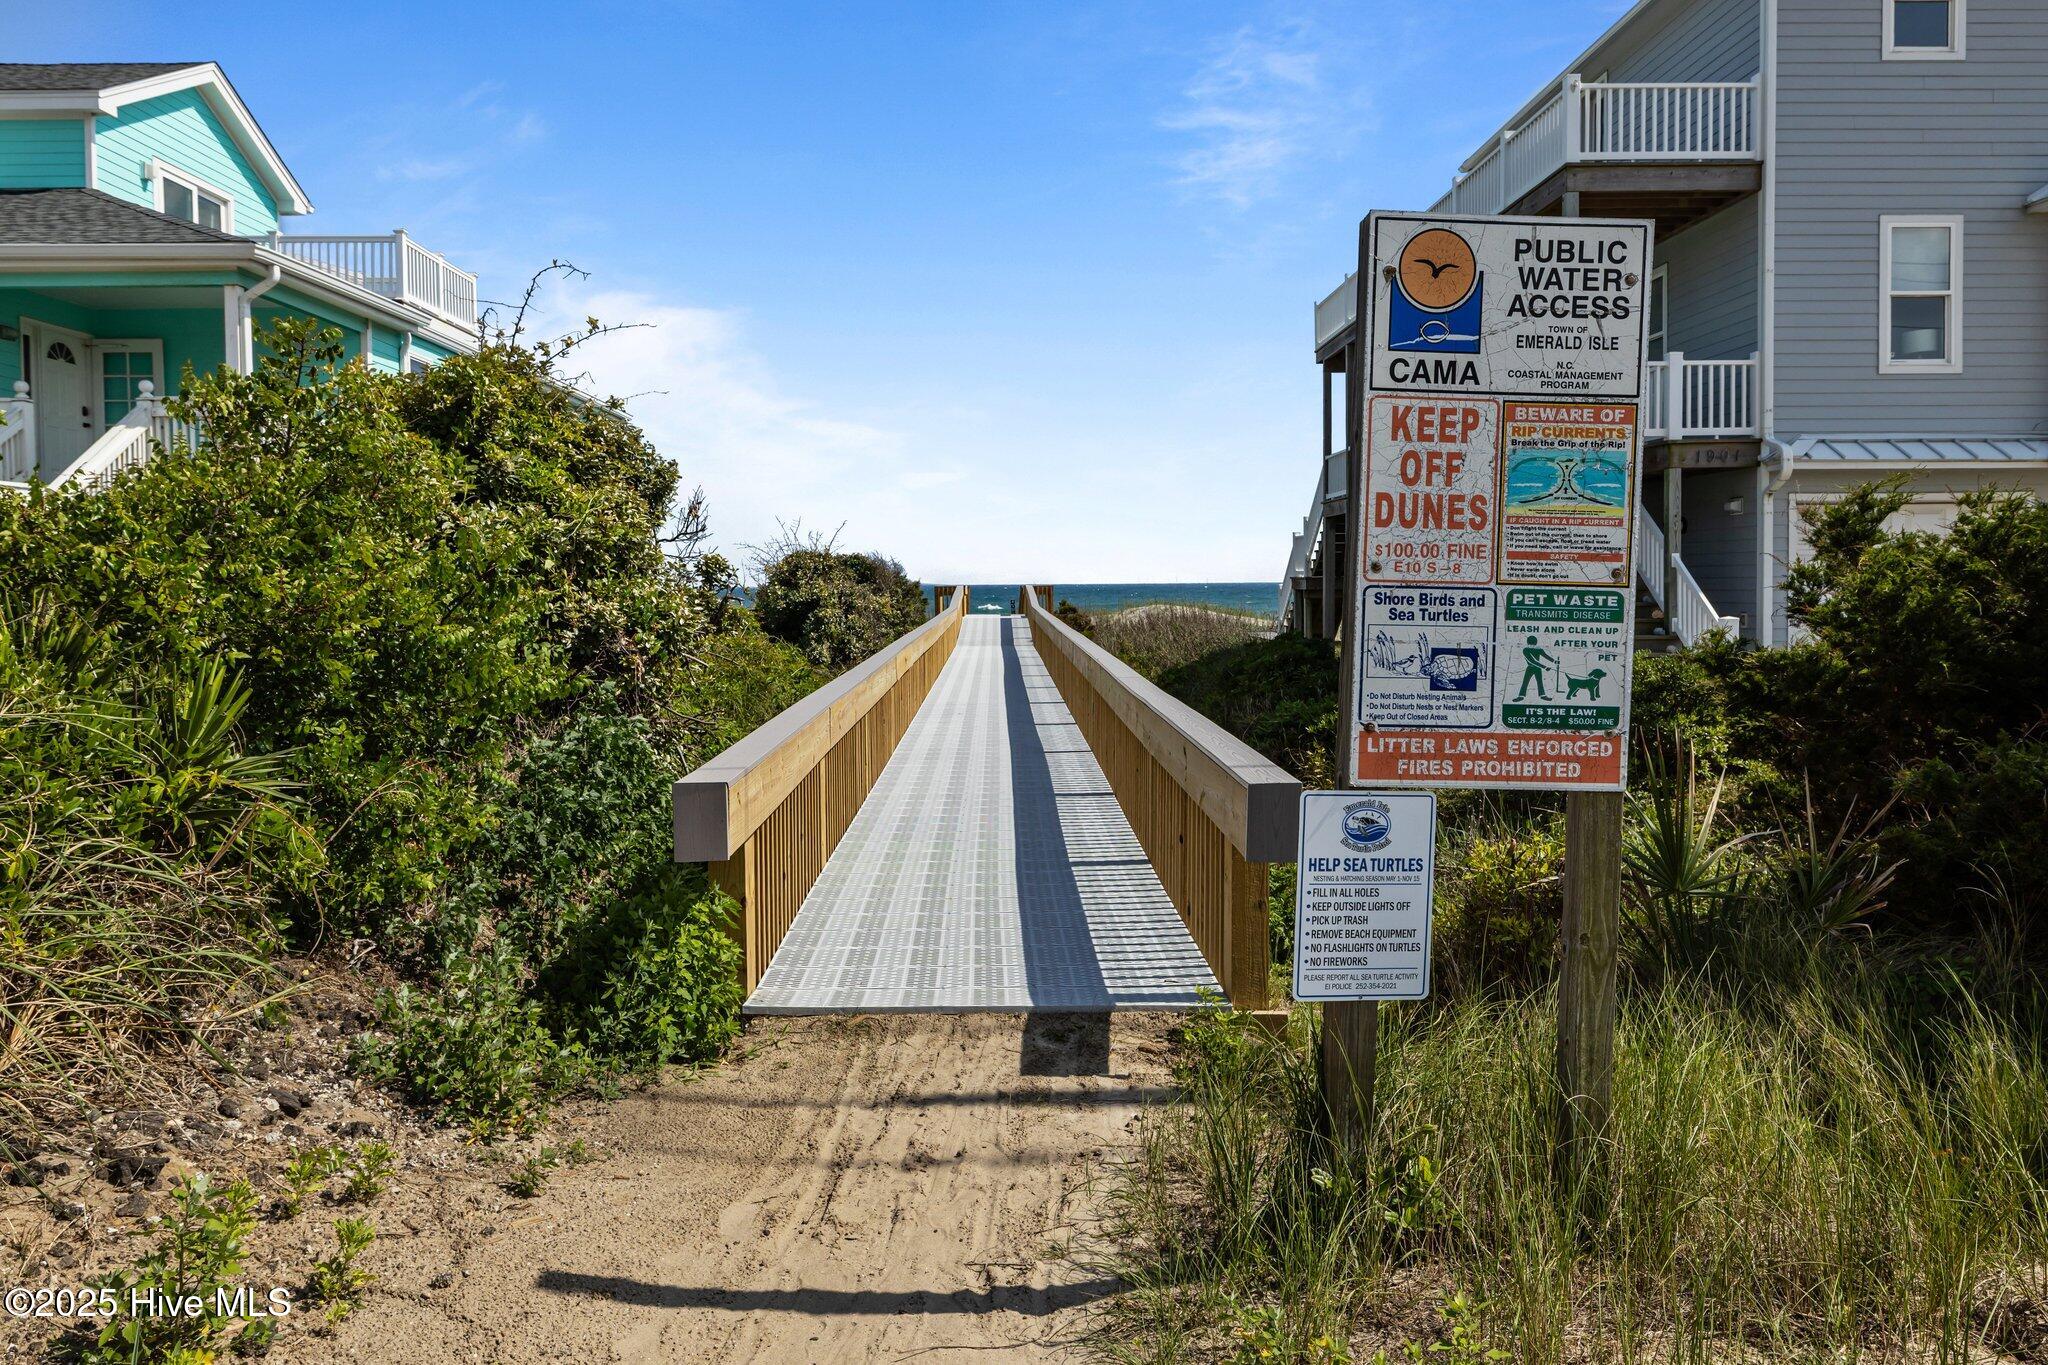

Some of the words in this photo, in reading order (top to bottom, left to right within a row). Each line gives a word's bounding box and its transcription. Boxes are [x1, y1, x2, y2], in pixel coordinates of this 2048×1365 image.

[1514, 238, 1628, 264] PUBLIC
[1518, 267, 1622, 292] WATER
[1507, 294, 1630, 319] ACCESS
[1516, 335, 1582, 350] EMERALD
[1588, 336, 1619, 351] ISLE
[1556, 361, 1575, 369] N.C.
[1389, 358, 1480, 386] CAMA
[1507, 370, 1551, 379] COASTAL
[1555, 371, 1623, 381] MANAGEMENT
[1540, 381, 1590, 390] PROGRAM
[1514, 407, 1594, 422] BEWARE
[1600, 409, 1625, 422] OF
[1391, 405, 1479, 443] KEEP
[1511, 426, 1537, 437] RIP
[1542, 426, 1627, 439] CURRENTS
[1540, 439, 1555, 447] the
[1558, 440, 1576, 448] Grip
[1579, 440, 1588, 448] of
[1590, 440, 1605, 448] the
[1608, 441, 1626, 449] Rip!
[1400, 450, 1463, 487] OFF
[1374, 492, 1488, 531] DUNES
[1375, 543, 1440, 558] $100.00
[1447, 544, 1487, 560] FINE
[1374, 591, 1415, 606] Shore
[1419, 592, 1456, 607] Birds
[1460, 594, 1485, 607] and
[1512, 593, 1547, 605] PET
[1553, 594, 1618, 607] WASTE
[1388, 607, 1415, 621] Sea
[1419, 608, 1469, 622] Turtles
[1515, 609, 1568, 619] TRANSMITS
[1573, 610, 1611, 620] DISEASE
[1507, 625, 1540, 633] LEASH
[1544, 626, 1564, 634] AND
[1568, 626, 1602, 635] CLEAN
[1606, 627, 1619, 635] UP
[1554, 640, 1588, 648] AFTER
[1591, 640, 1618, 648] YOUR
[1598, 654, 1618, 662] PET
[1416, 693, 1441, 702] Nesting
[1441, 693, 1467, 701] Animals
[1443, 703, 1458, 711] Nest
[1547, 708, 1566, 716] THE
[1570, 708, 1597, 716] LAW!
[1369, 713, 1386, 721] Keep
[1529, 717, 1560, 725] 8-2/8-4
[1367, 737, 1436, 754] LITTER
[1444, 738, 1499, 755] LAWS
[1507, 739, 1613, 757] ENFORCED
[1397, 759, 1453, 776] FIRES
[1461, 760, 1581, 778] PROHIBITED
[1308, 858, 1340, 872] HELP
[1343, 858, 1368, 872] SEA
[1371, 858, 1424, 872] TURTLES
[1312, 888, 1328, 898] FILL
[1329, 888, 1338, 897] IN
[1340, 888, 1353, 897] ALL
[1354, 888, 1379, 897] HOLES
[1312, 902, 1332, 911] KEEP
[1333, 902, 1367, 911] OUTSIDE
[1368, 902, 1395, 911] LIGHTS
[1396, 902, 1411, 911] OFF
[1311, 916, 1330, 925] PICK
[1331, 916, 1342, 925] UP
[1343, 916, 1368, 925] TRASH
[1311, 929, 1343, 939] REMOVE
[1345, 929, 1370, 939] BEACH
[1372, 929, 1417, 940] EQUIPMENT
[1310, 943, 1322, 952] NO
[1323, 943, 1374, 952] FLASHLIGHTS
[1376, 943, 1387, 952] ON
[1389, 942, 1421, 952] TURTLES
[1309, 957, 1321, 966] NO
[1323, 957, 1368, 966] FIREWORKS
